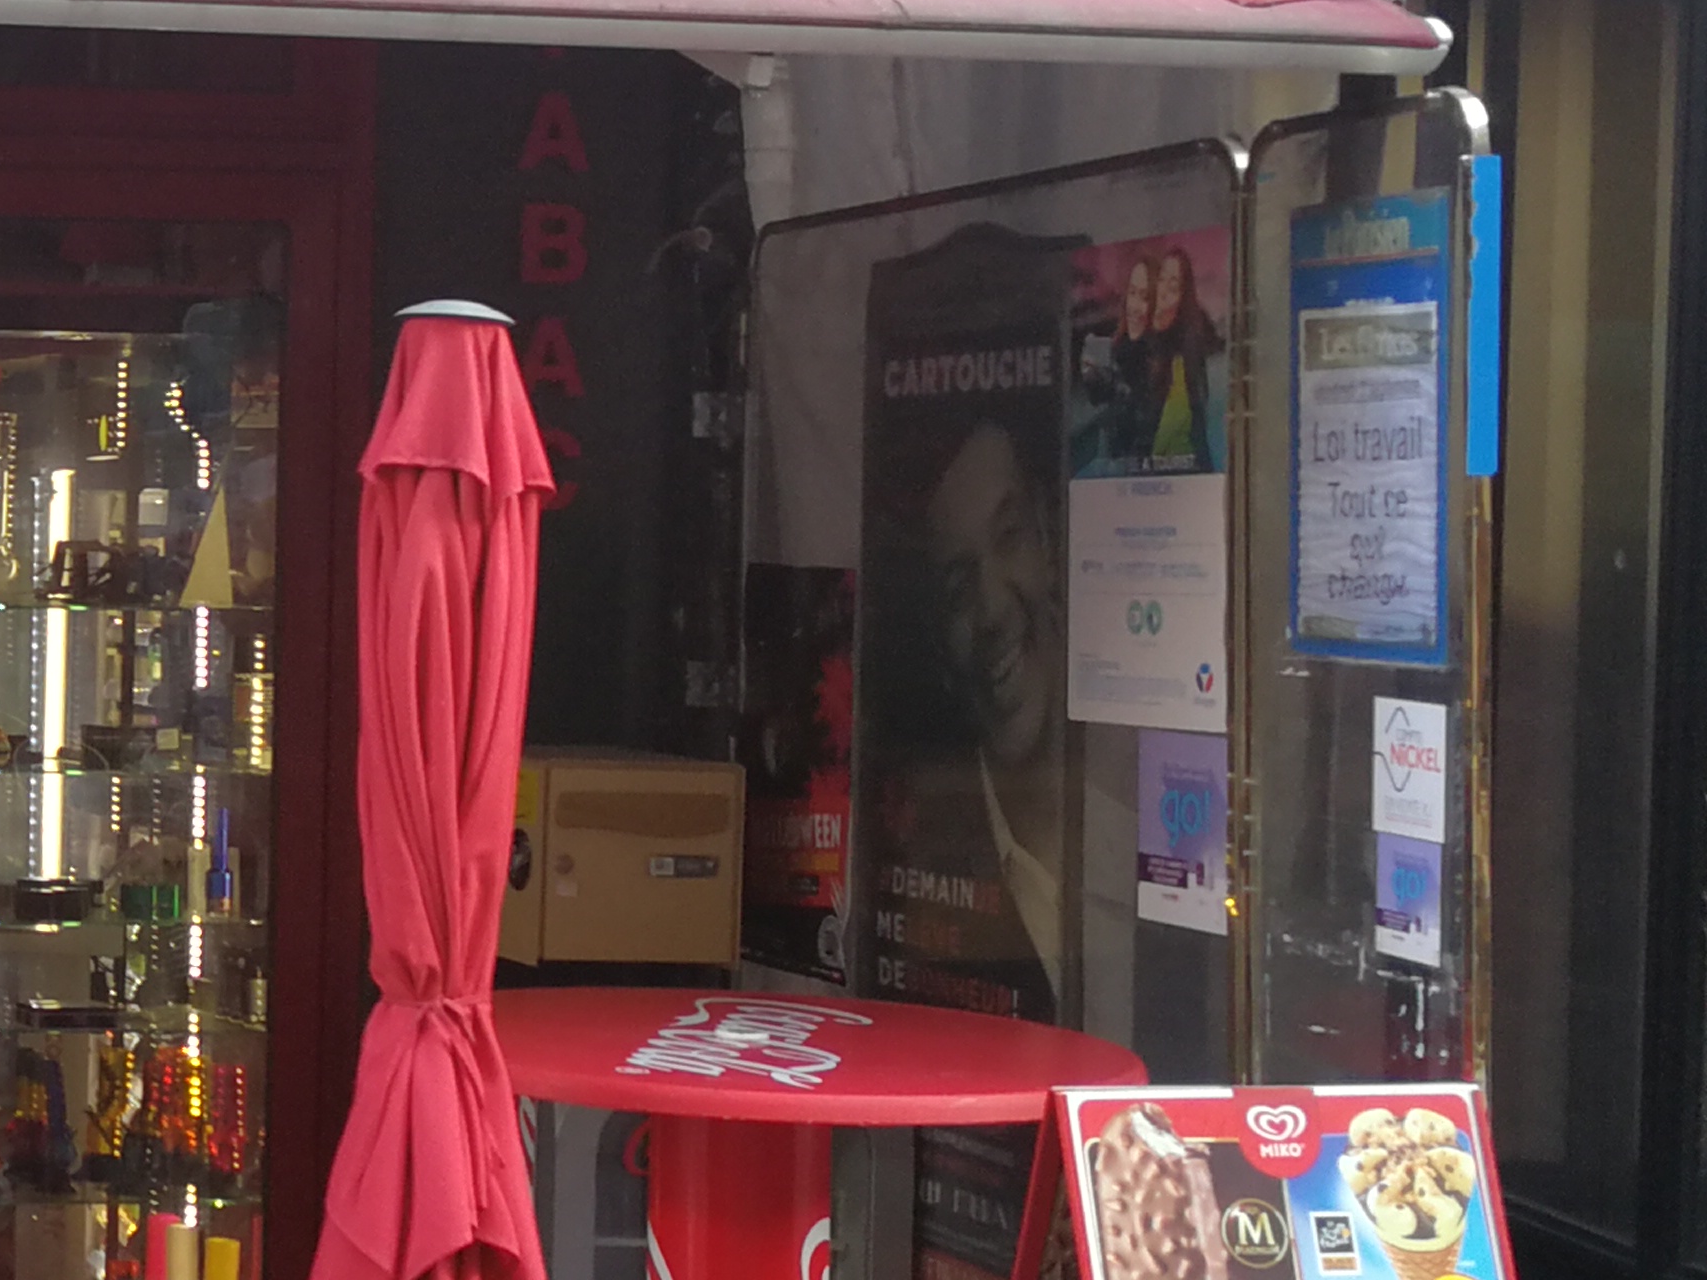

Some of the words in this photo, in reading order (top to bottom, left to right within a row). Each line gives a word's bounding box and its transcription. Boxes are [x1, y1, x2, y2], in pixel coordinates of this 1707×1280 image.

[884, 345, 1052, 398] CARTOUCHE
[1353, 417, 1423, 462] travail
[1328, 482, 1376, 520] Tout
[891, 866, 974, 910] DEMAIN
[877, 910, 906, 943] ME
[878, 956, 907, 990] DE
[1259, 1143, 1302, 1158] MIKO
